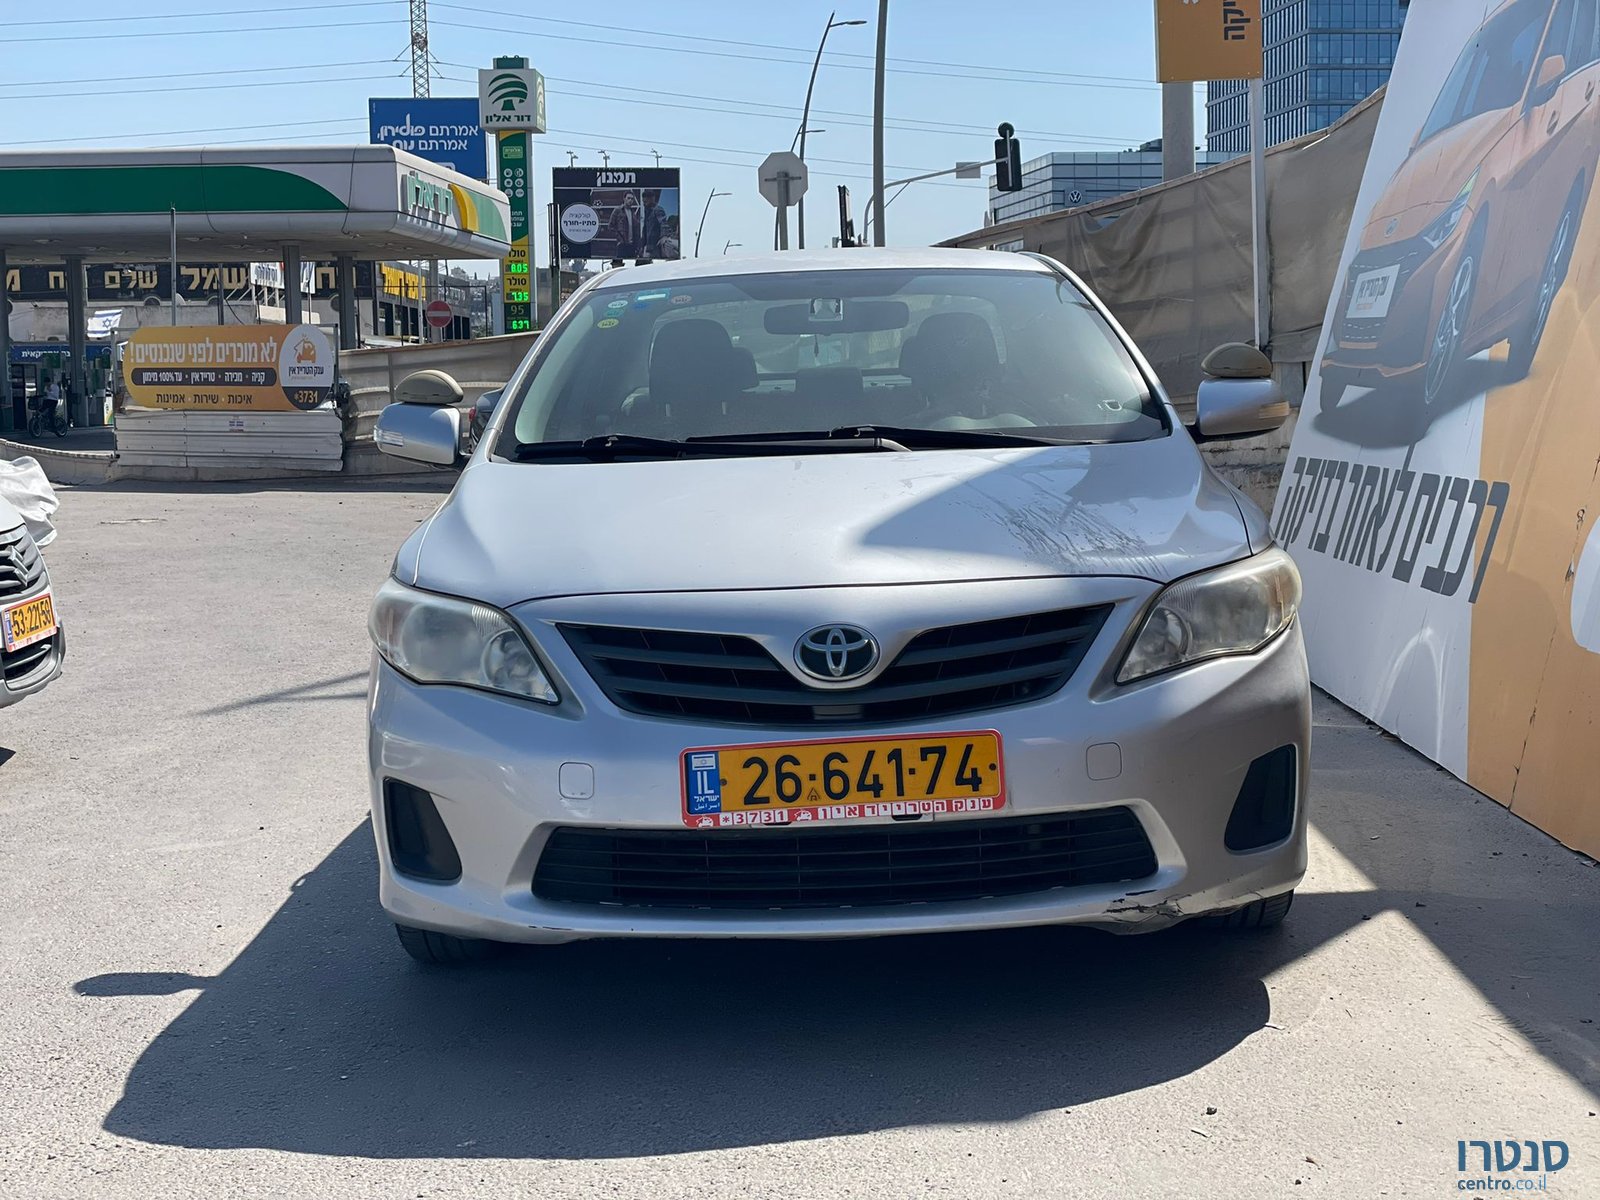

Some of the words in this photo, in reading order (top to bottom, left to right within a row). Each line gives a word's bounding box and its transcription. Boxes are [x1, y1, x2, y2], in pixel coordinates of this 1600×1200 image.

[1222, 0, 1251, 40] יקה
[485, 113, 512, 124] אלון
[429, 125, 478, 136] אמרתם
[418, 139, 468, 151] אמרתם
[596, 171, 636, 187] תמנון
[507, 277, 527, 286] סולר
[510, 305, 525, 315] 95
[130, 341, 186, 363] שנכנסים!
[189, 337, 213, 363] לפני
[216, 341, 258, 363] מוכרים
[260, 336, 277, 363] לא
[224, 371, 243, 383] מכירה
[251, 371, 265, 384] קניה
[313, 366, 325, 377] ענק
[156, 393, 186, 404] אמינות
[193, 393, 219, 404] שירות
[227, 393, 253, 404] איכות
[1274, 456, 1350, 554] בדיקה
[1333, 443, 1421, 574] לאחר
[1391, 472, 1510, 604] רכבים
[696, 770, 715, 795] IL
[694, 794, 720, 803] ישראל
[954, 798, 991, 812] ענק
[866, 800, 945, 816] הטרייד
